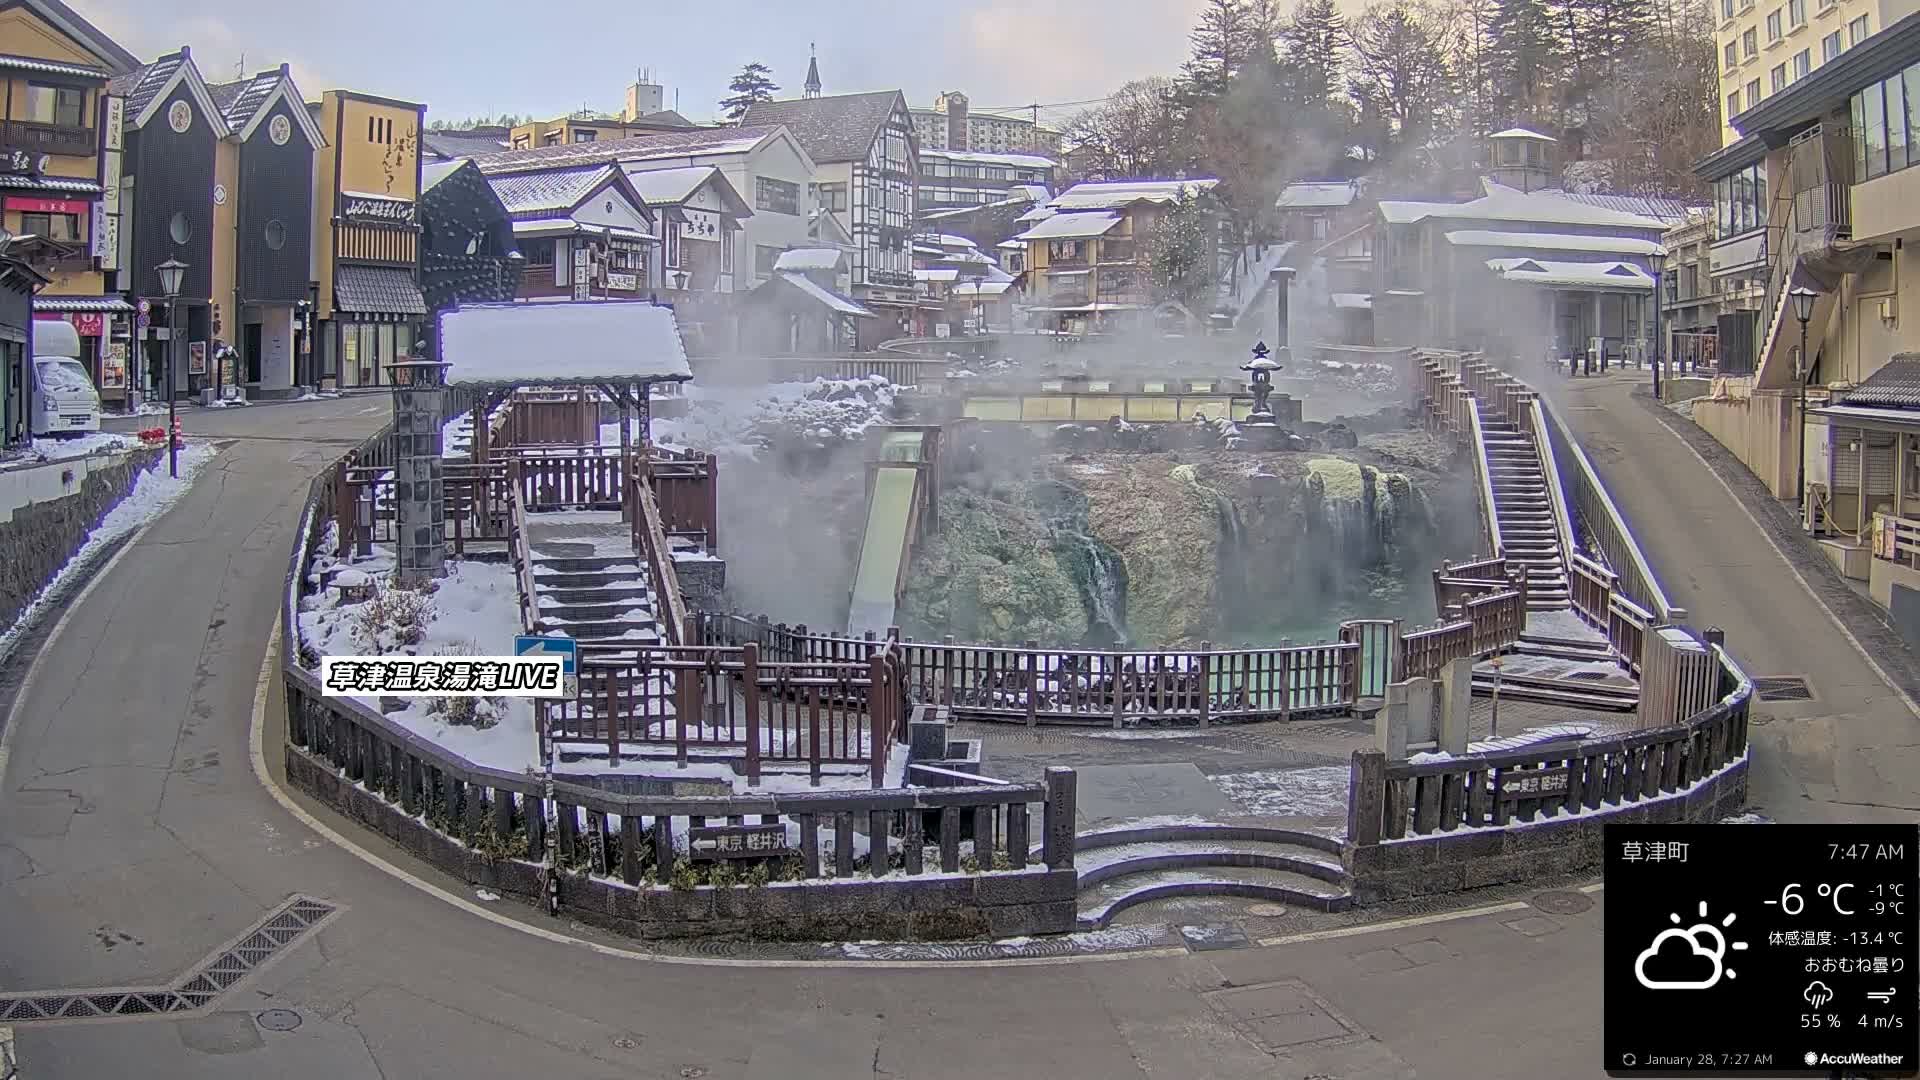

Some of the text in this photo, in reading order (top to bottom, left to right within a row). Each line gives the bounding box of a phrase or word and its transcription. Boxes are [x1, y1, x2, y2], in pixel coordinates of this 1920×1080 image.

[716, 832, 786, 852] 東京 軽井沢
